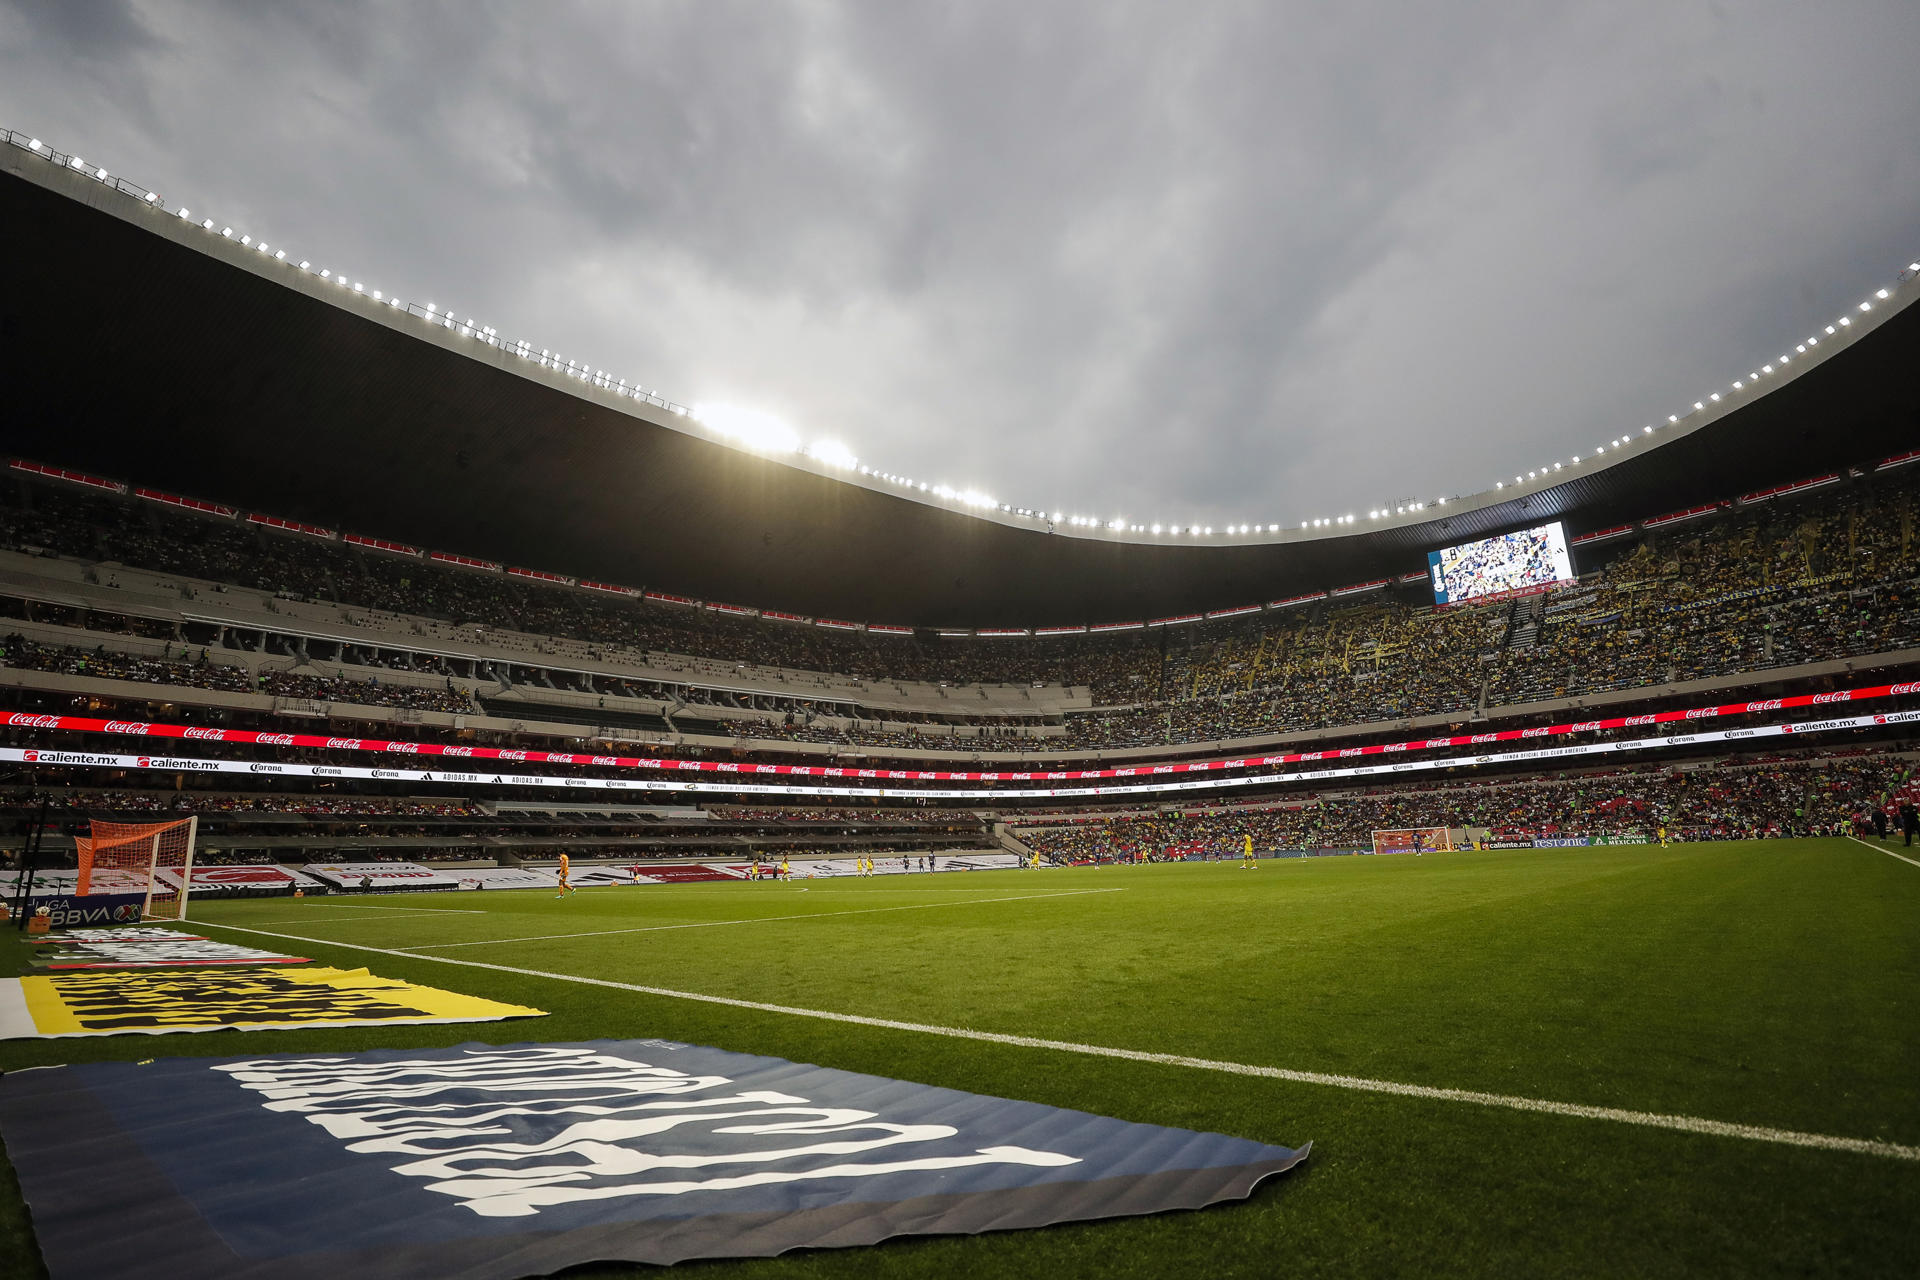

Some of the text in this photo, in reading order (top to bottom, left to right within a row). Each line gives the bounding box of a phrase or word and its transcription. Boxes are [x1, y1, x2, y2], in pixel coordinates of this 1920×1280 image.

[1794, 719, 1858, 732] caliente.mx
[1724, 729, 1755, 739] Corona
[1667, 736, 1696, 745] Corona
[1616, 742, 1642, 750] Corona
[39, 753, 118, 765] caliente.mx
[150, 758, 219, 770] caliente.mx
[250, 763, 282, 773] Corona
[311, 767, 341, 776] Corona
[371, 770, 399, 779] Corona
[1490, 841, 1532, 849] caliente.mx
[36, 900, 70, 911] LIGA
[51, 906, 110, 926] BBVA
